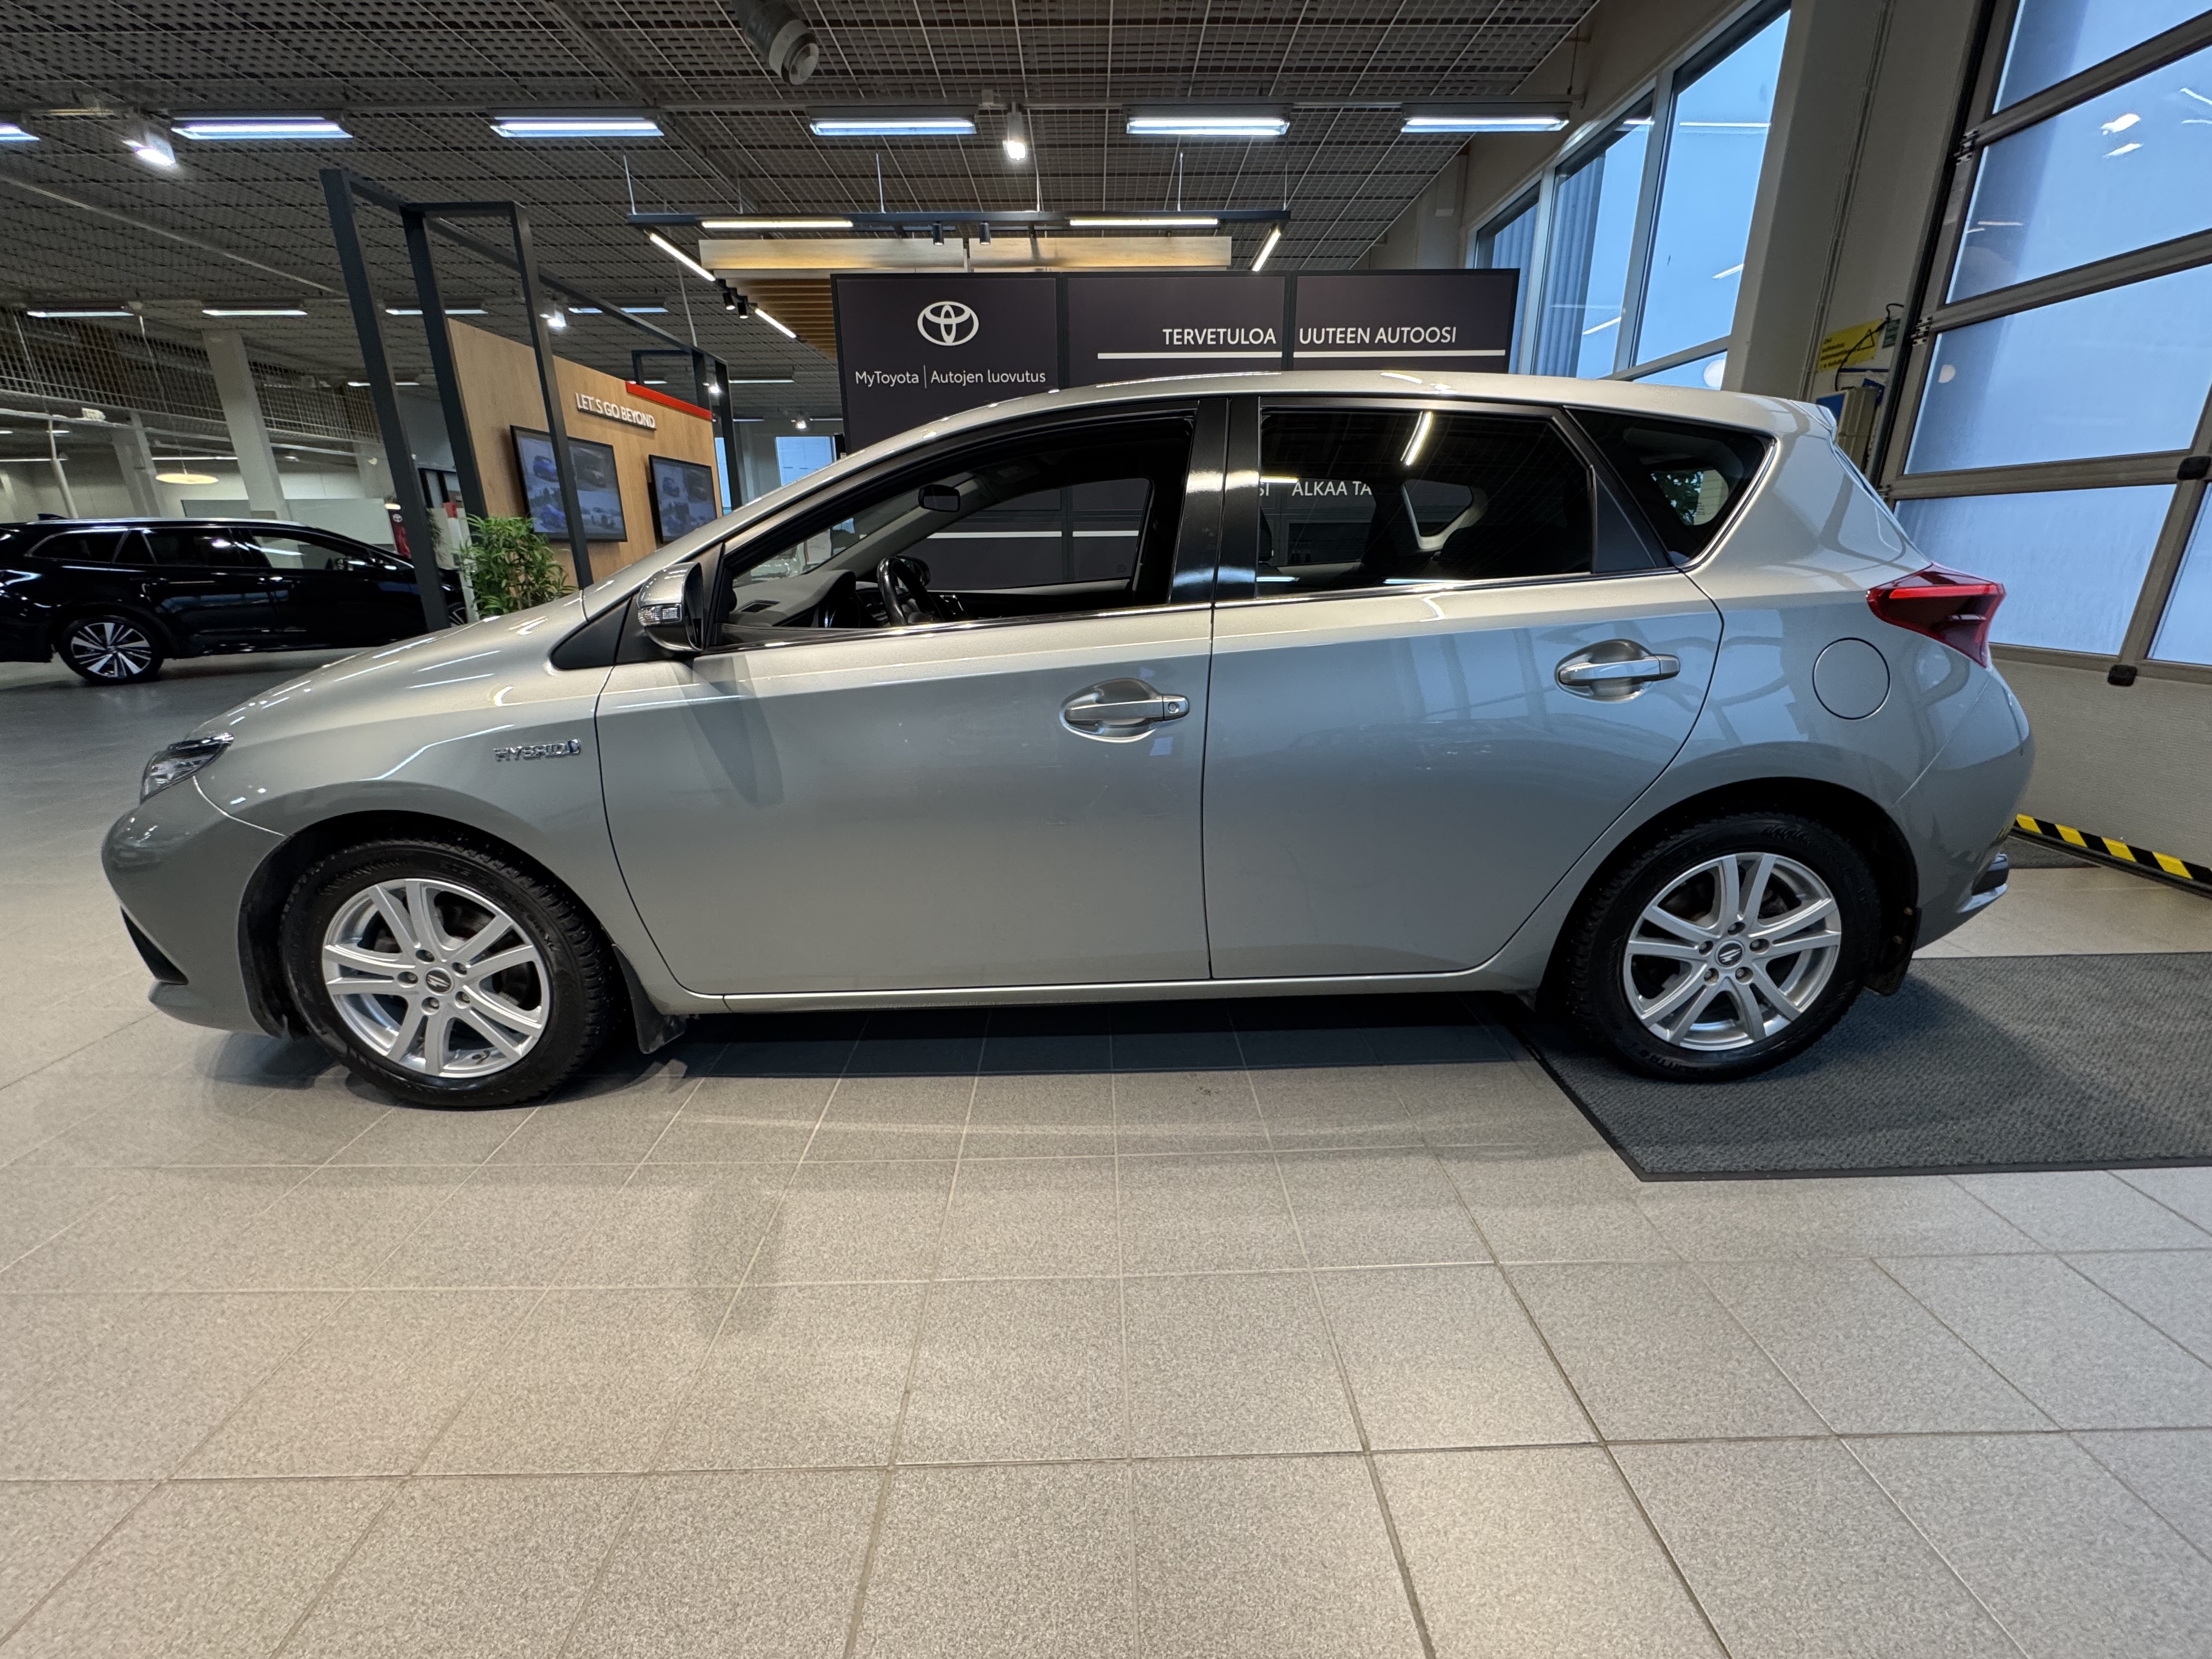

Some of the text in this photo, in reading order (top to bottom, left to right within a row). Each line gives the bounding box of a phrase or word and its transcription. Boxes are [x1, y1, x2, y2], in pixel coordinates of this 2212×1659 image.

[1162, 326, 1457, 346] TERVETULOA UUTEEN AUTOOSI
[855, 369, 1046, 388] MyToyota Autojen luovutus
[603, 401, 620, 419] GO
[620, 405, 656, 428] BEYOND
[1291, 481, 1348, 496] ALKAA
[493, 742, 568, 762] HYBRID
